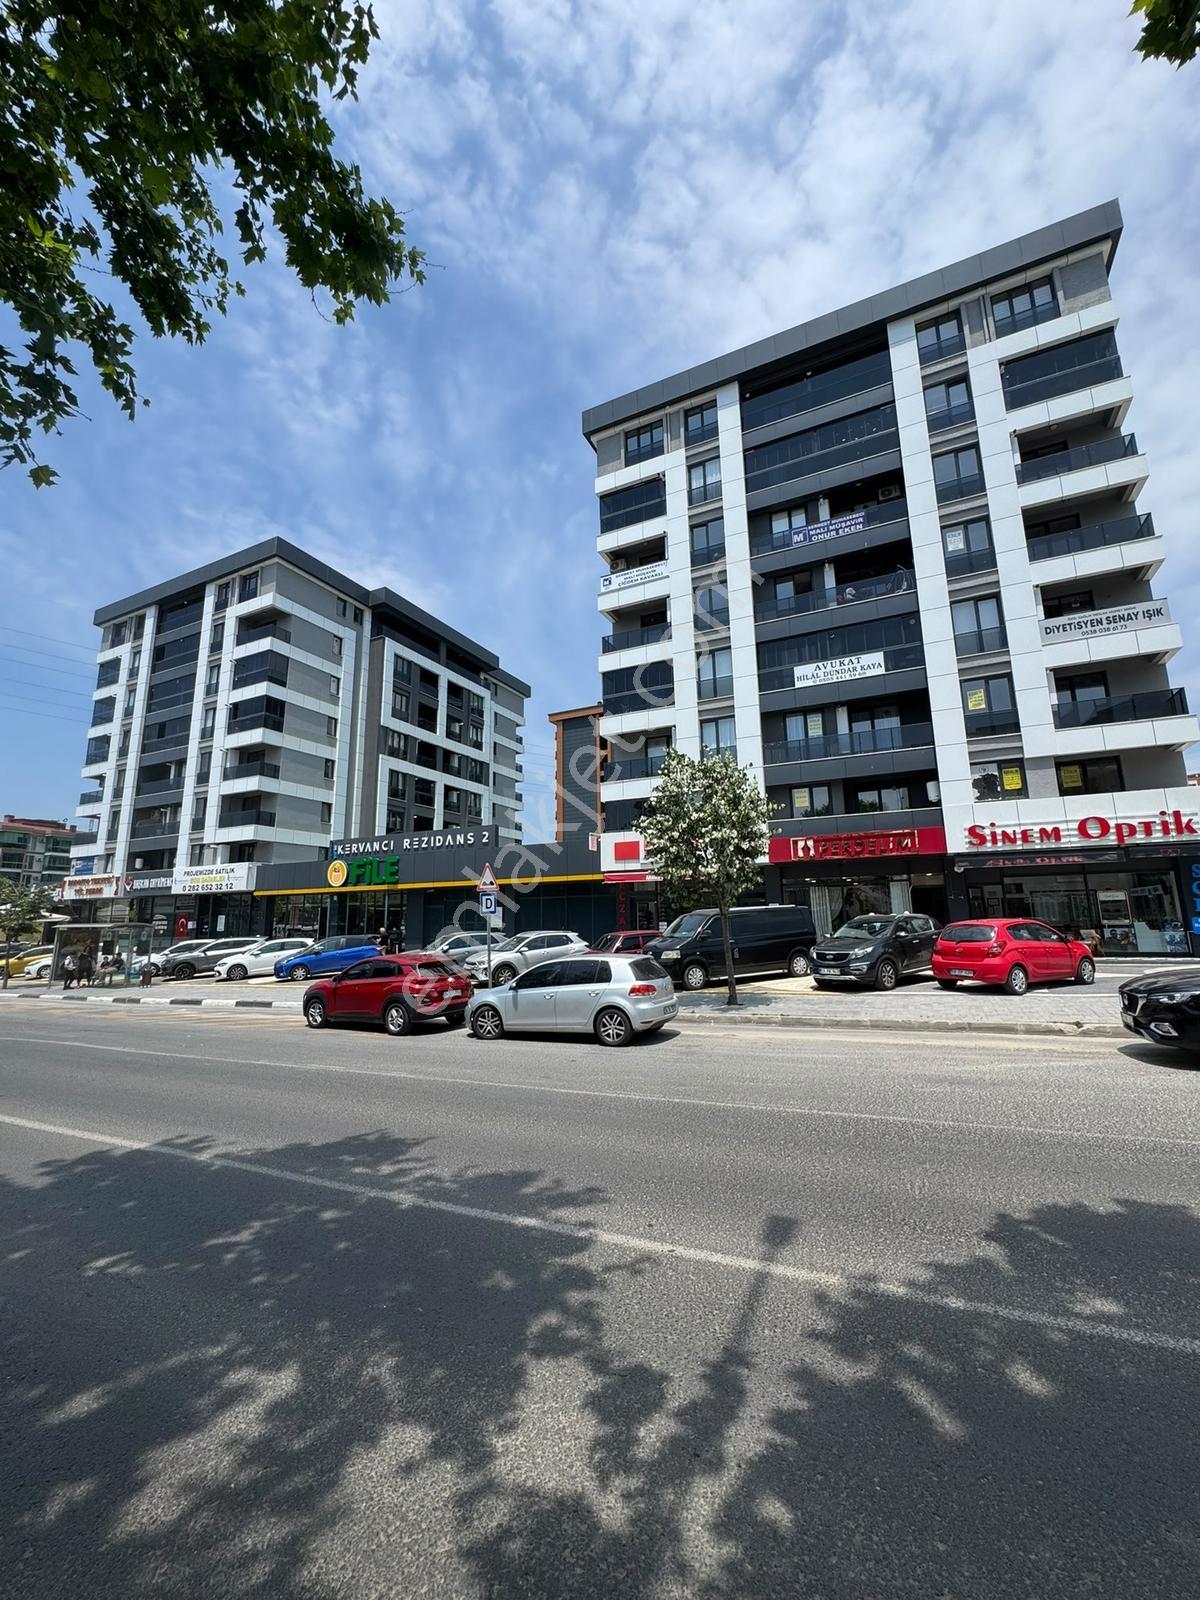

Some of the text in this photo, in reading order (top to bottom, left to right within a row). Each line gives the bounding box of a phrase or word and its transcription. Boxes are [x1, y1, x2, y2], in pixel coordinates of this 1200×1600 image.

[811, 524, 863, 541] ONUR EKEN
[1105, 611, 1140, 625] SENAY
[1142, 607, 1164, 621] IŞIK
[813, 656, 862, 672] AVUKAT
[860, 662, 883, 672] KAYA
[337, 831, 489, 855] KERVANCI REZIDANS 2
[188, 884, 200, 892] 282
[224, 882, 234, 890] 12
[485, 897, 493, 909] D
